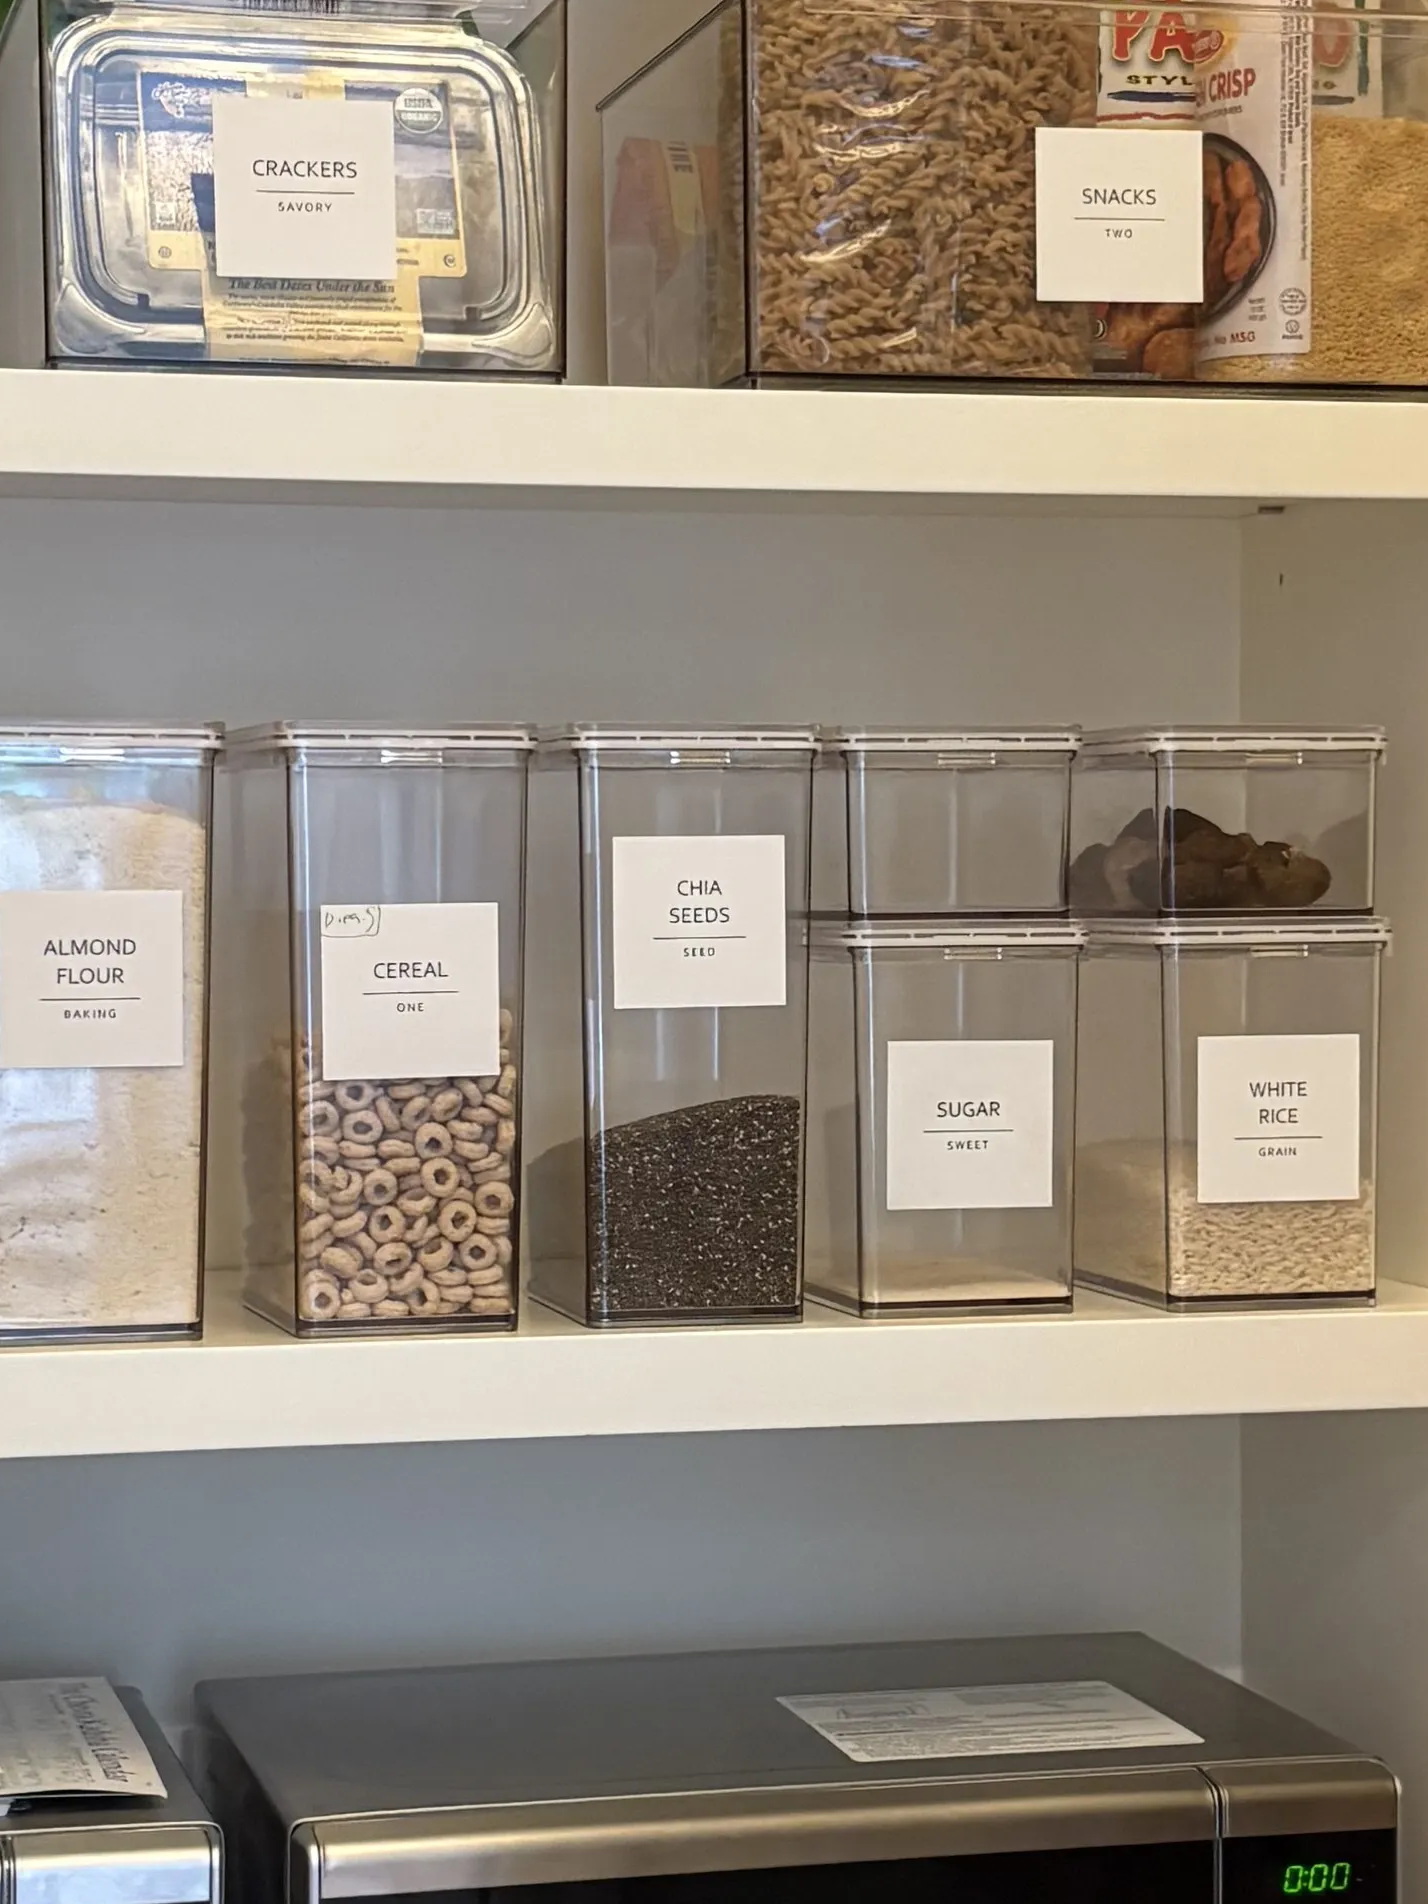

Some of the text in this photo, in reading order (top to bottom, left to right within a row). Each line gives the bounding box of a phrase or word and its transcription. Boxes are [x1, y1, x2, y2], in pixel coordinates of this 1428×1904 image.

[252, 159, 358, 179] CRACKERS
[1081, 185, 1159, 208] SNACKS
[278, 201, 333, 214] SAVORY
[1103, 227, 1134, 239] TWO
[228, 278, 396, 294] The Dates Under the Sun
[1229, 330, 1257, 344] MSG
[677, 879, 722, 897] CHIA
[669, 906, 731, 924] SEEDS
[43, 938, 137, 957] ALMOND
[682, 947, 716, 958] SEED
[56, 967, 125, 985] FLOUR
[373, 960, 449, 980] CEREAL
[63, 1007, 118, 1020] BAKING
[396, 1001, 425, 1013] ONE
[1249, 1081, 1308, 1097] WHITE
[936, 1101, 1001, 1119] SUGAR
[1258, 1108, 1299, 1125] RICE
[946, 1139, 990, 1151] SWEET
[1258, 1147, 1297, 1158] GRAIN
[1283, 1862, 1351, 1893] 0:00
